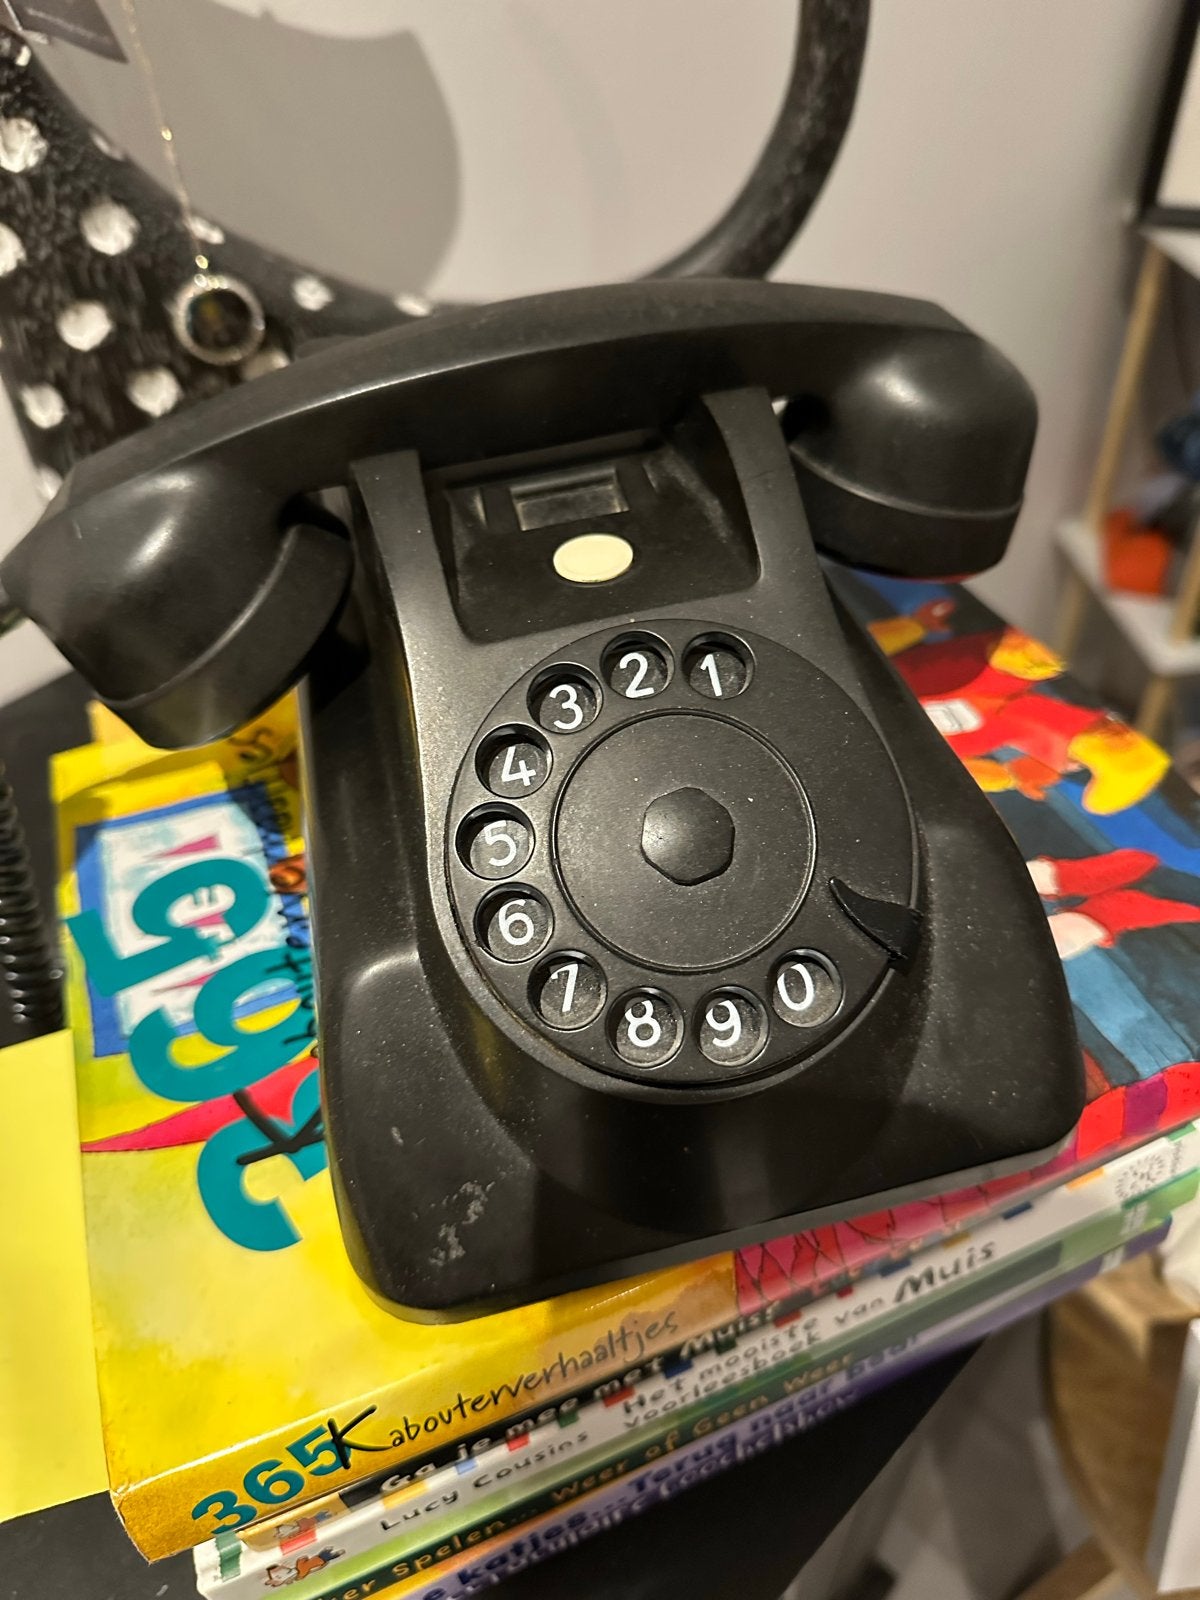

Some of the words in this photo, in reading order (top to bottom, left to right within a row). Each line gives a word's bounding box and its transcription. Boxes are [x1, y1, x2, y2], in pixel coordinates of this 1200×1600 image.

[618, 652, 654, 698] 2
[700, 653, 723, 697] 1
[548, 683, 583, 730] 3
[500, 745, 537, 787] 4
[484, 820, 518, 867] 5
[498, 899, 534, 947] 6
[549, 963, 580, 1013] 7
[776, 963, 814, 1012] 0
[624, 1000, 661, 1048] 8
[705, 1000, 742, 1047] 9
[623, 1377, 687, 1414] Het
[699, 1316, 819, 1381] mooiste
[834, 1297, 885, 1324] van
[894, 1241, 996, 1302] Muis
[624, 1331, 821, 1428] voorleesboek
[380, 1461, 436, 1492] Ga
[456, 1437, 492, 1461] je
[505, 1397, 579, 1440] mee
[593, 1355, 665, 1400] met
[552, 1459, 630, 1501] Weer
[645, 1430, 679, 1461] of
[692, 1395, 769, 1439] Geen
[783, 1353, 852, 1394] Weer
[191, 1424, 352, 1535] 365
[381, 1489, 459, 1531] Lucy
[473, 1431, 588, 1488] Cousins
